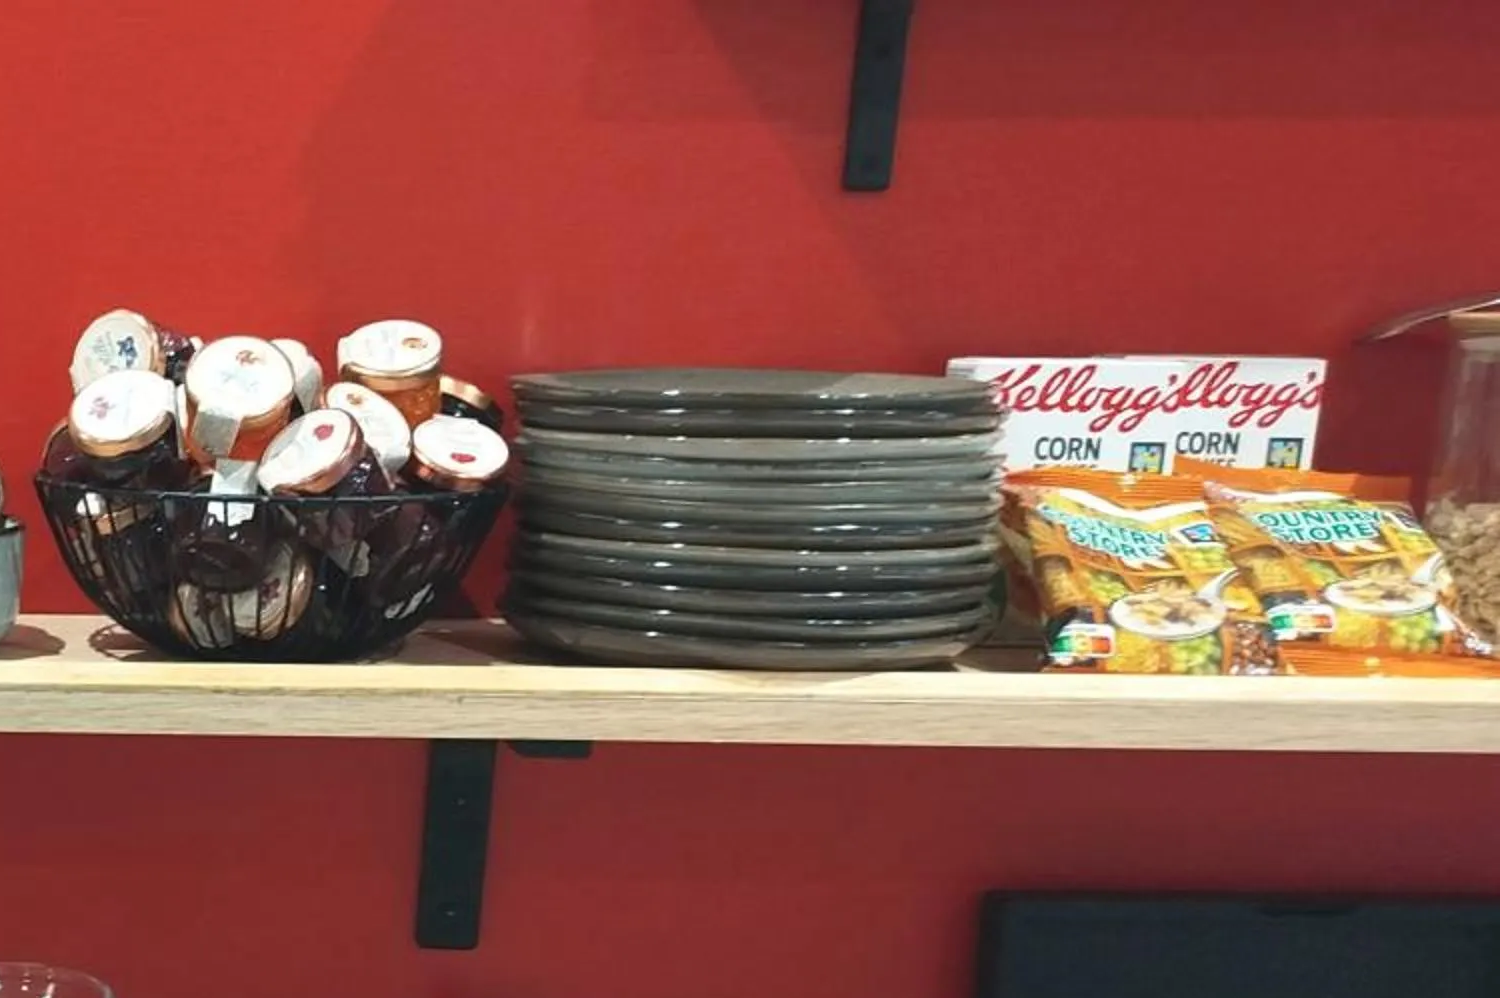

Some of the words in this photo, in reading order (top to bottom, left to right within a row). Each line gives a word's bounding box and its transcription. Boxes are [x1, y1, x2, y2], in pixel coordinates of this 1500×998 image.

[990, 364, 1180, 433] Kellogg's
[1175, 361, 1324, 429] llogg's
[1034, 436, 1102, 461] CORN
[1175, 431, 1241, 456] CORN
[1257, 509, 1379, 528] OUNTRY
